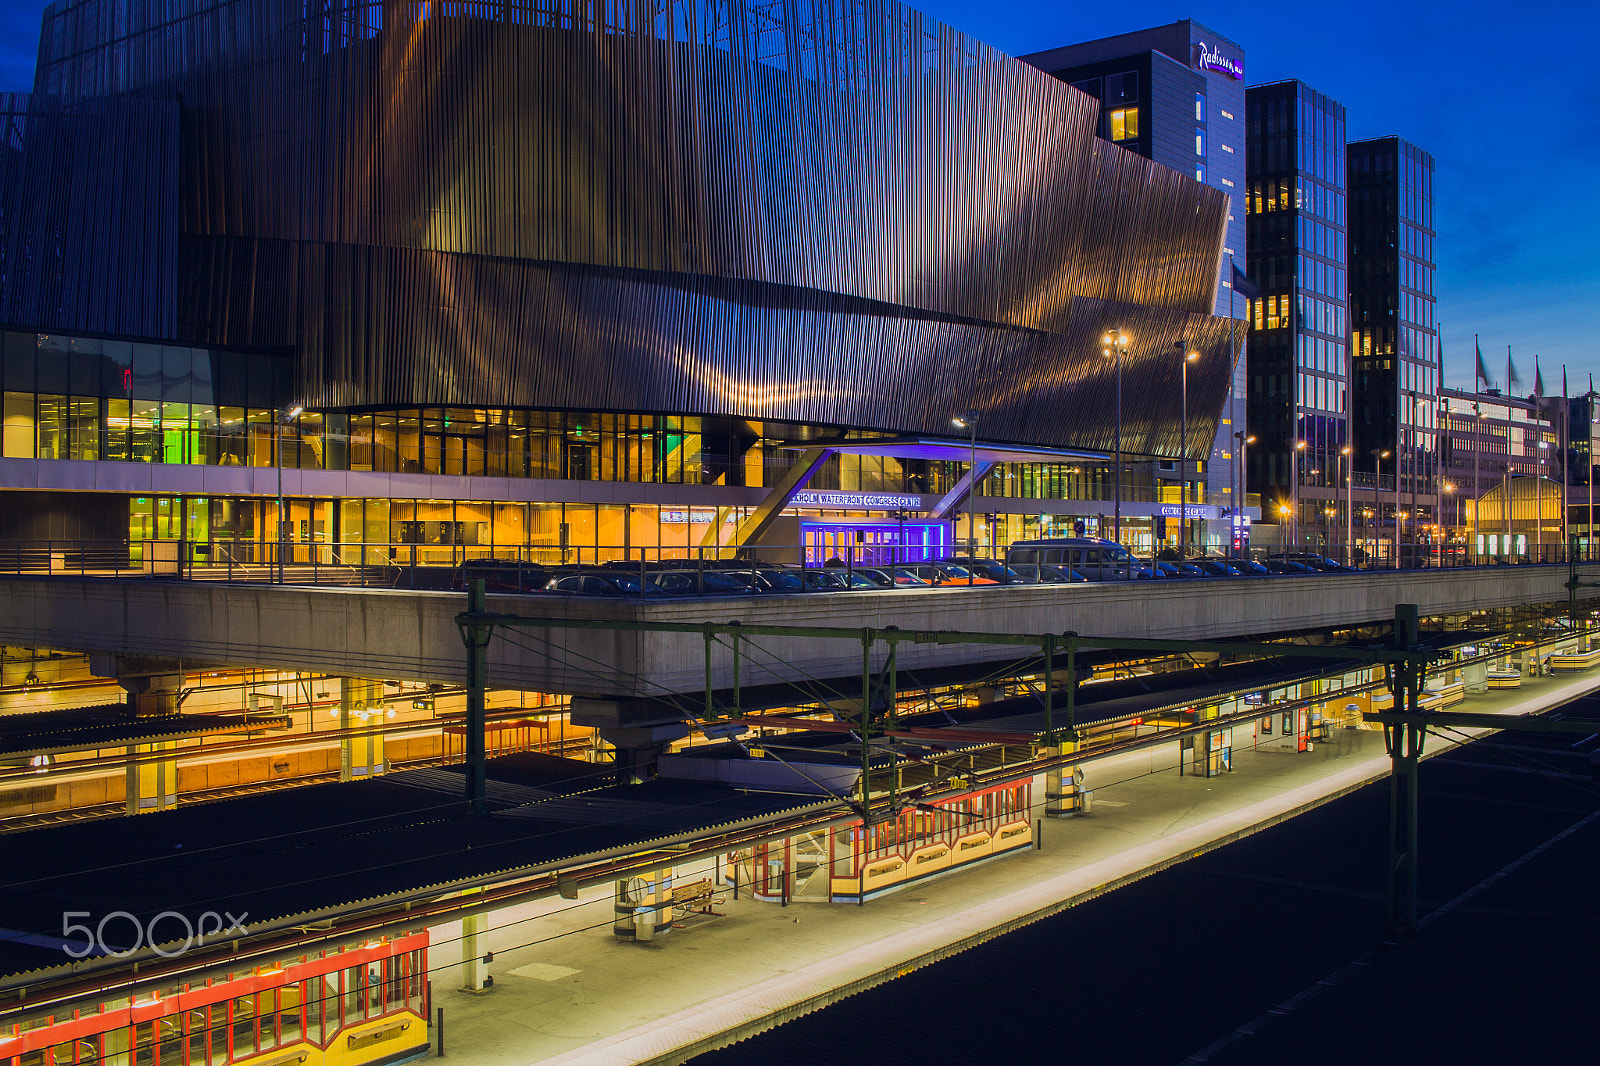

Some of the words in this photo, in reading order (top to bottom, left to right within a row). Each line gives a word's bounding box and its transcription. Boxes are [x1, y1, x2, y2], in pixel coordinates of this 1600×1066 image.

[1199, 41, 1234, 73] Radisson
[819, 494, 864, 505] WATERFRONT
[864, 495, 898, 506] CONGRESS
